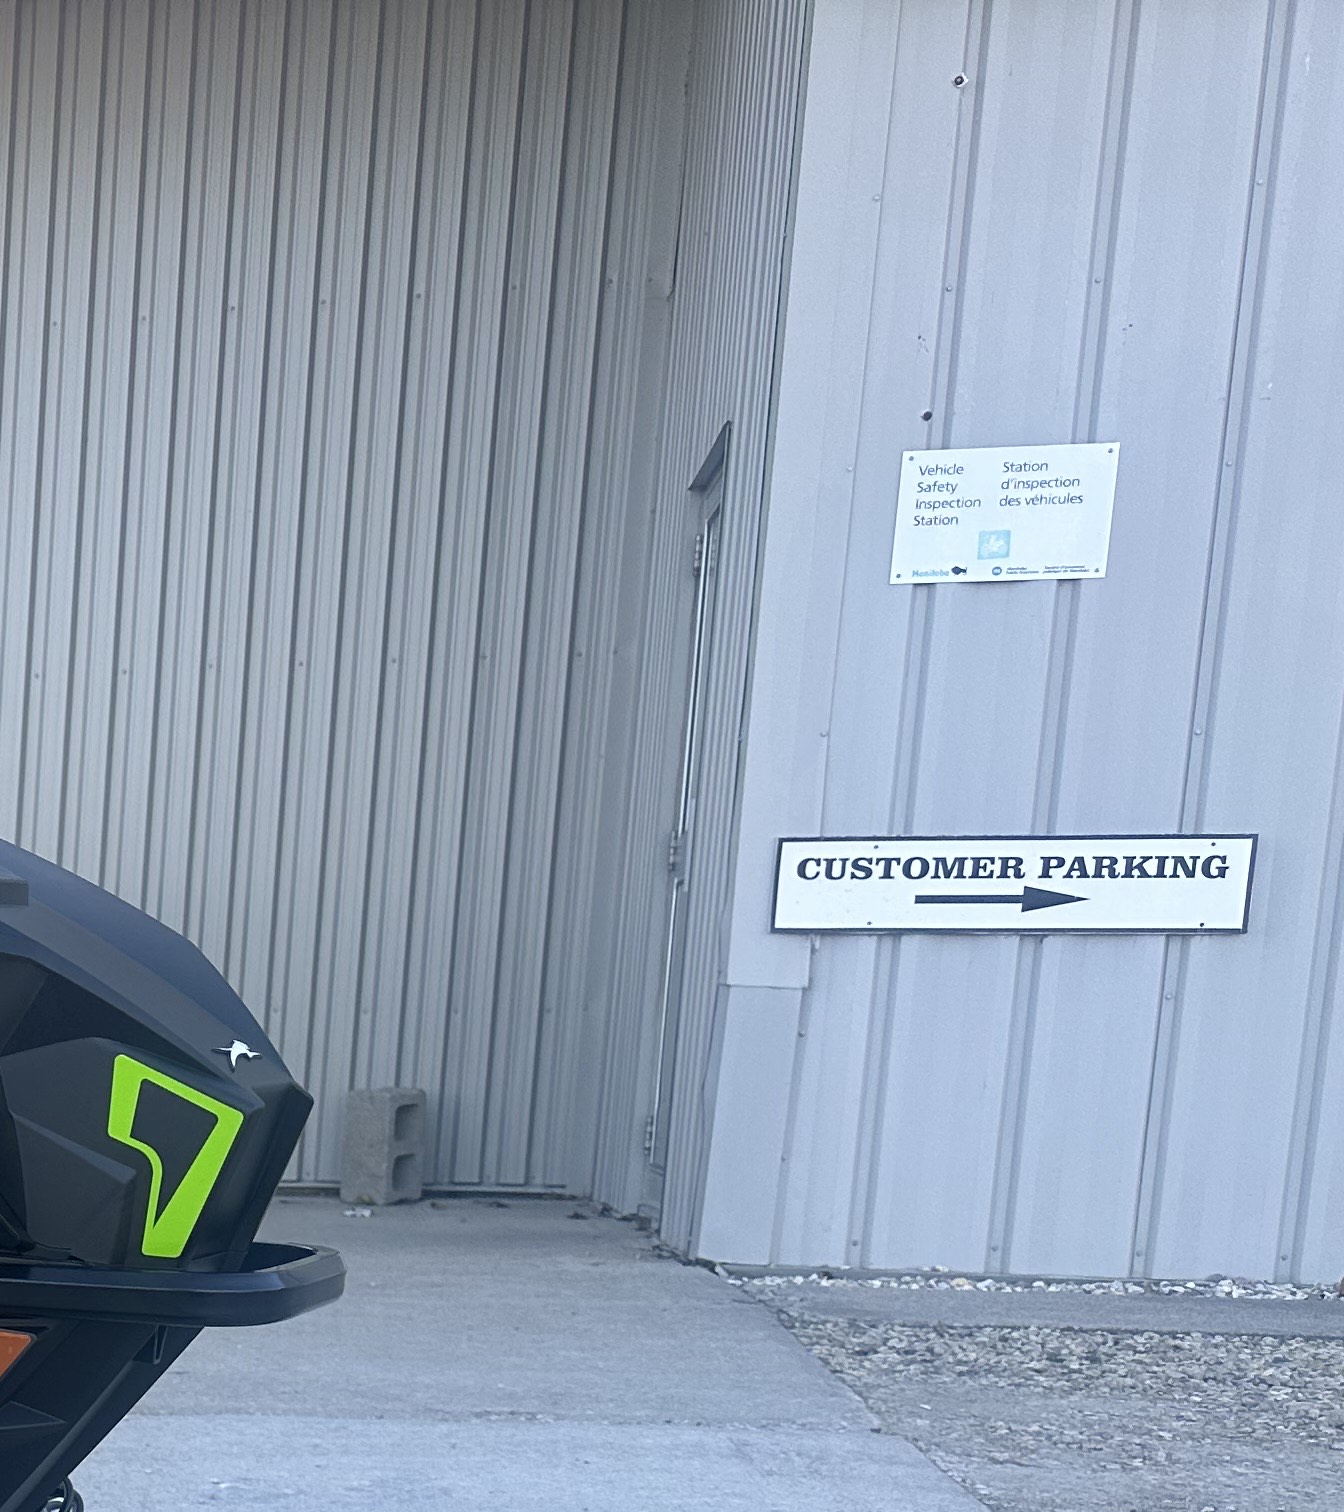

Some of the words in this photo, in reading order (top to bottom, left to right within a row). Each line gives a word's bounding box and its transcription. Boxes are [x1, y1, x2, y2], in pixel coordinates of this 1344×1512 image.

[919, 463, 964, 476] Vehicle
[1002, 460, 1049, 473] Station
[917, 481, 958, 495] Safety
[1001, 477, 1080, 491] d'inspection
[915, 497, 981, 510] Inspection
[999, 494, 1021, 507] des
[1025, 493, 1083, 506] véhicules
[913, 514, 959, 527] Station
[796, 856, 1026, 880] CUSTOMER
[1038, 855, 1230, 880] PARKING
